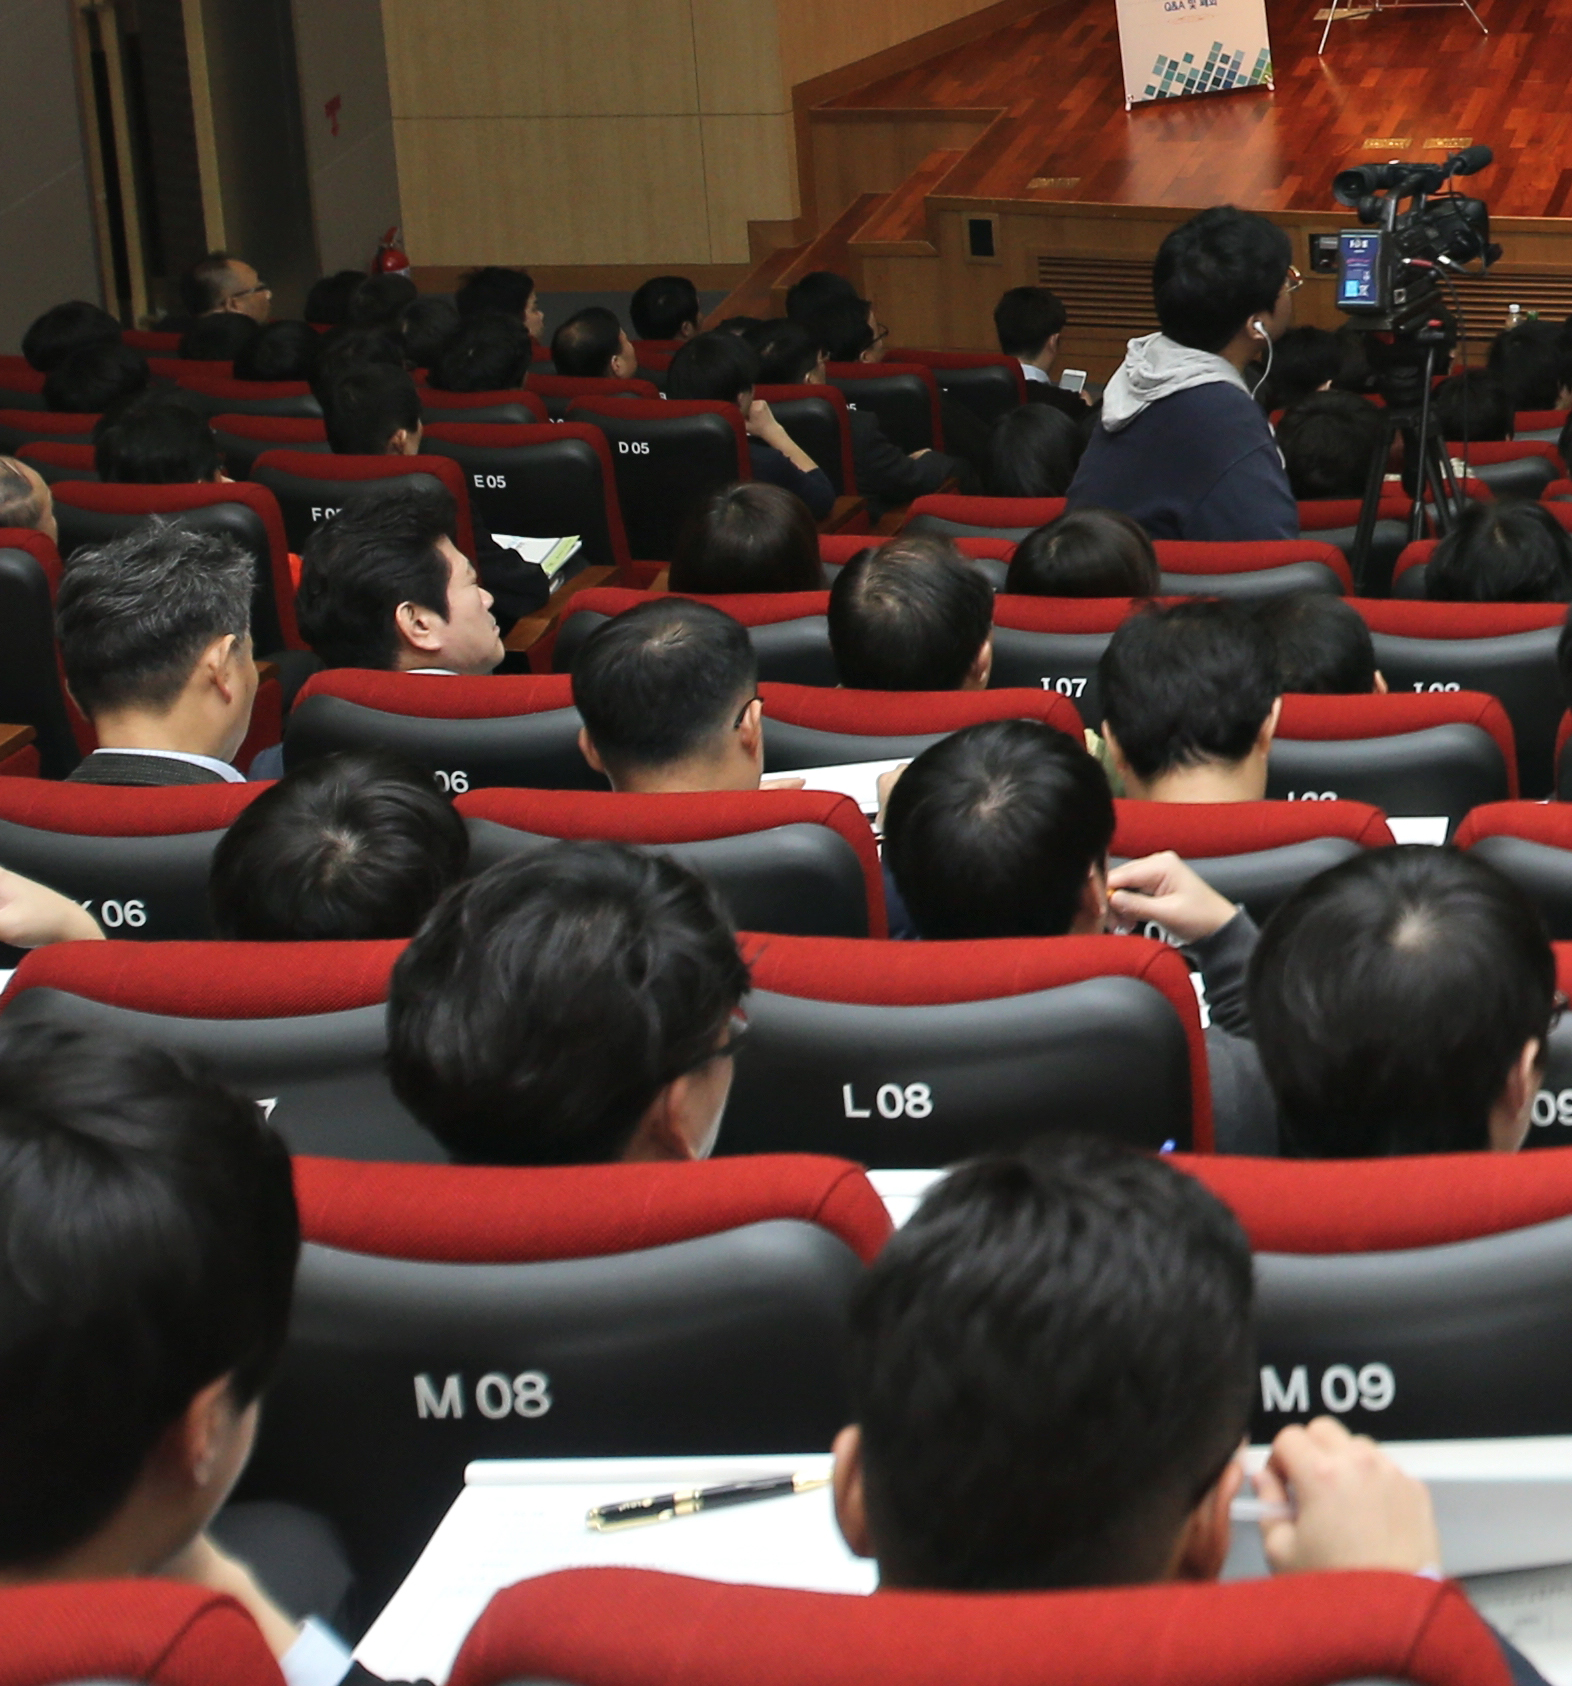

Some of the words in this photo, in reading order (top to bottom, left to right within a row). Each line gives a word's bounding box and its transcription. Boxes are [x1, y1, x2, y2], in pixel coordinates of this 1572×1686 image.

[1164, 1, 1186, 12] Q&A
[631, 442, 650, 454] 05
[486, 474, 507, 488] 05
[1055, 677, 1088, 698] 07
[433, 770, 469, 793] 06
[101, 900, 147, 928] 06
[842, 1083, 872, 1118] L
[876, 1083, 934, 1119] 08
[413, 1372, 463, 1419] M
[475, 1370, 552, 1419] 08
[1260, 1365, 1311, 1413] M
[1320, 1363, 1396, 1413] 09
